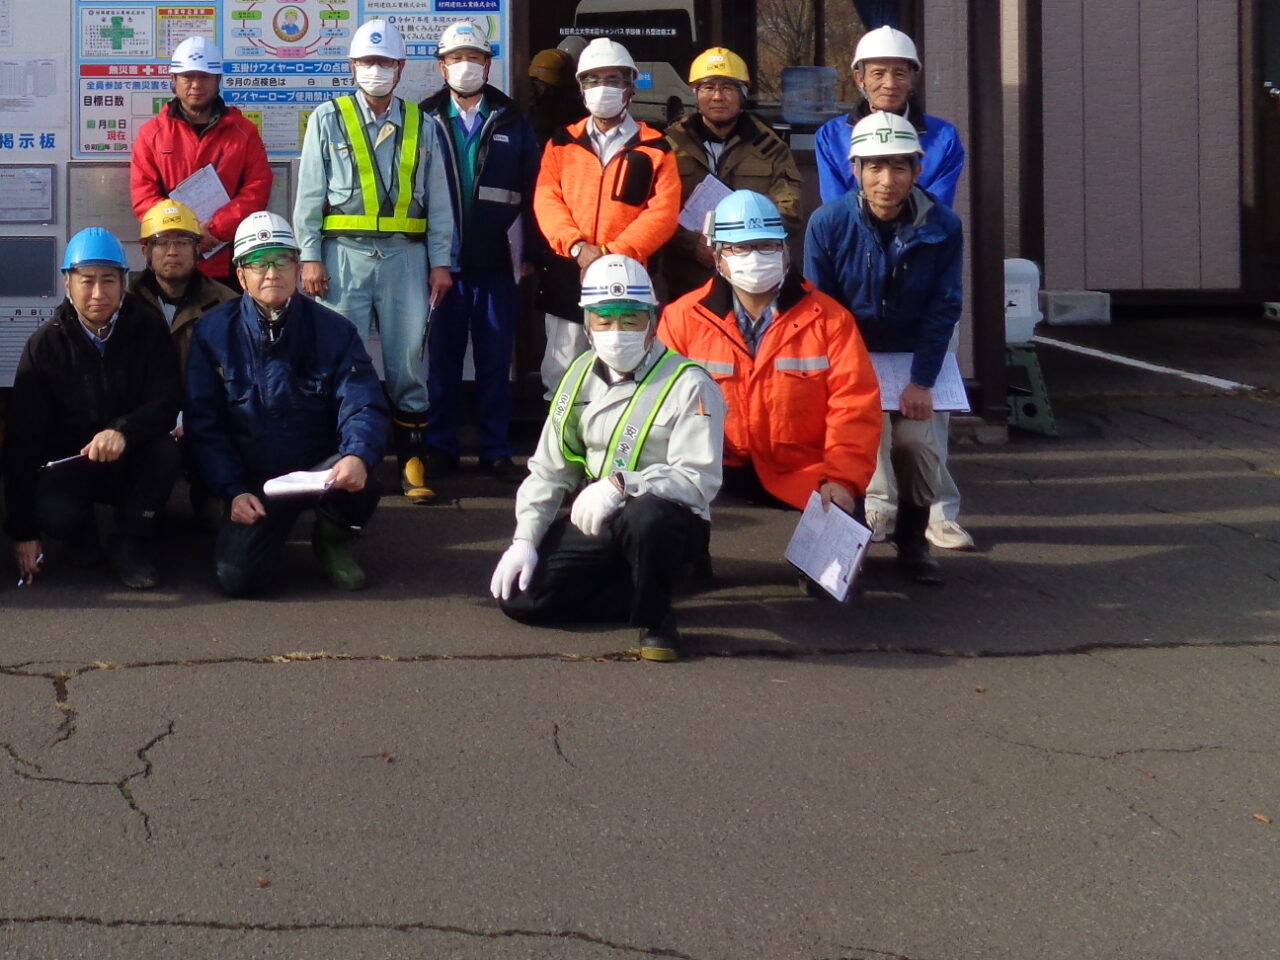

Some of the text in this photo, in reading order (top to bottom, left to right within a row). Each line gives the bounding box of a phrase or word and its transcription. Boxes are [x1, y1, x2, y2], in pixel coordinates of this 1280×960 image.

[108, 65, 138, 74] 無災害
[226, 78, 286, 87] 今月の点検色は
[83, 96, 124, 107] 目標日数
[107, 131, 126, 140] 現在
